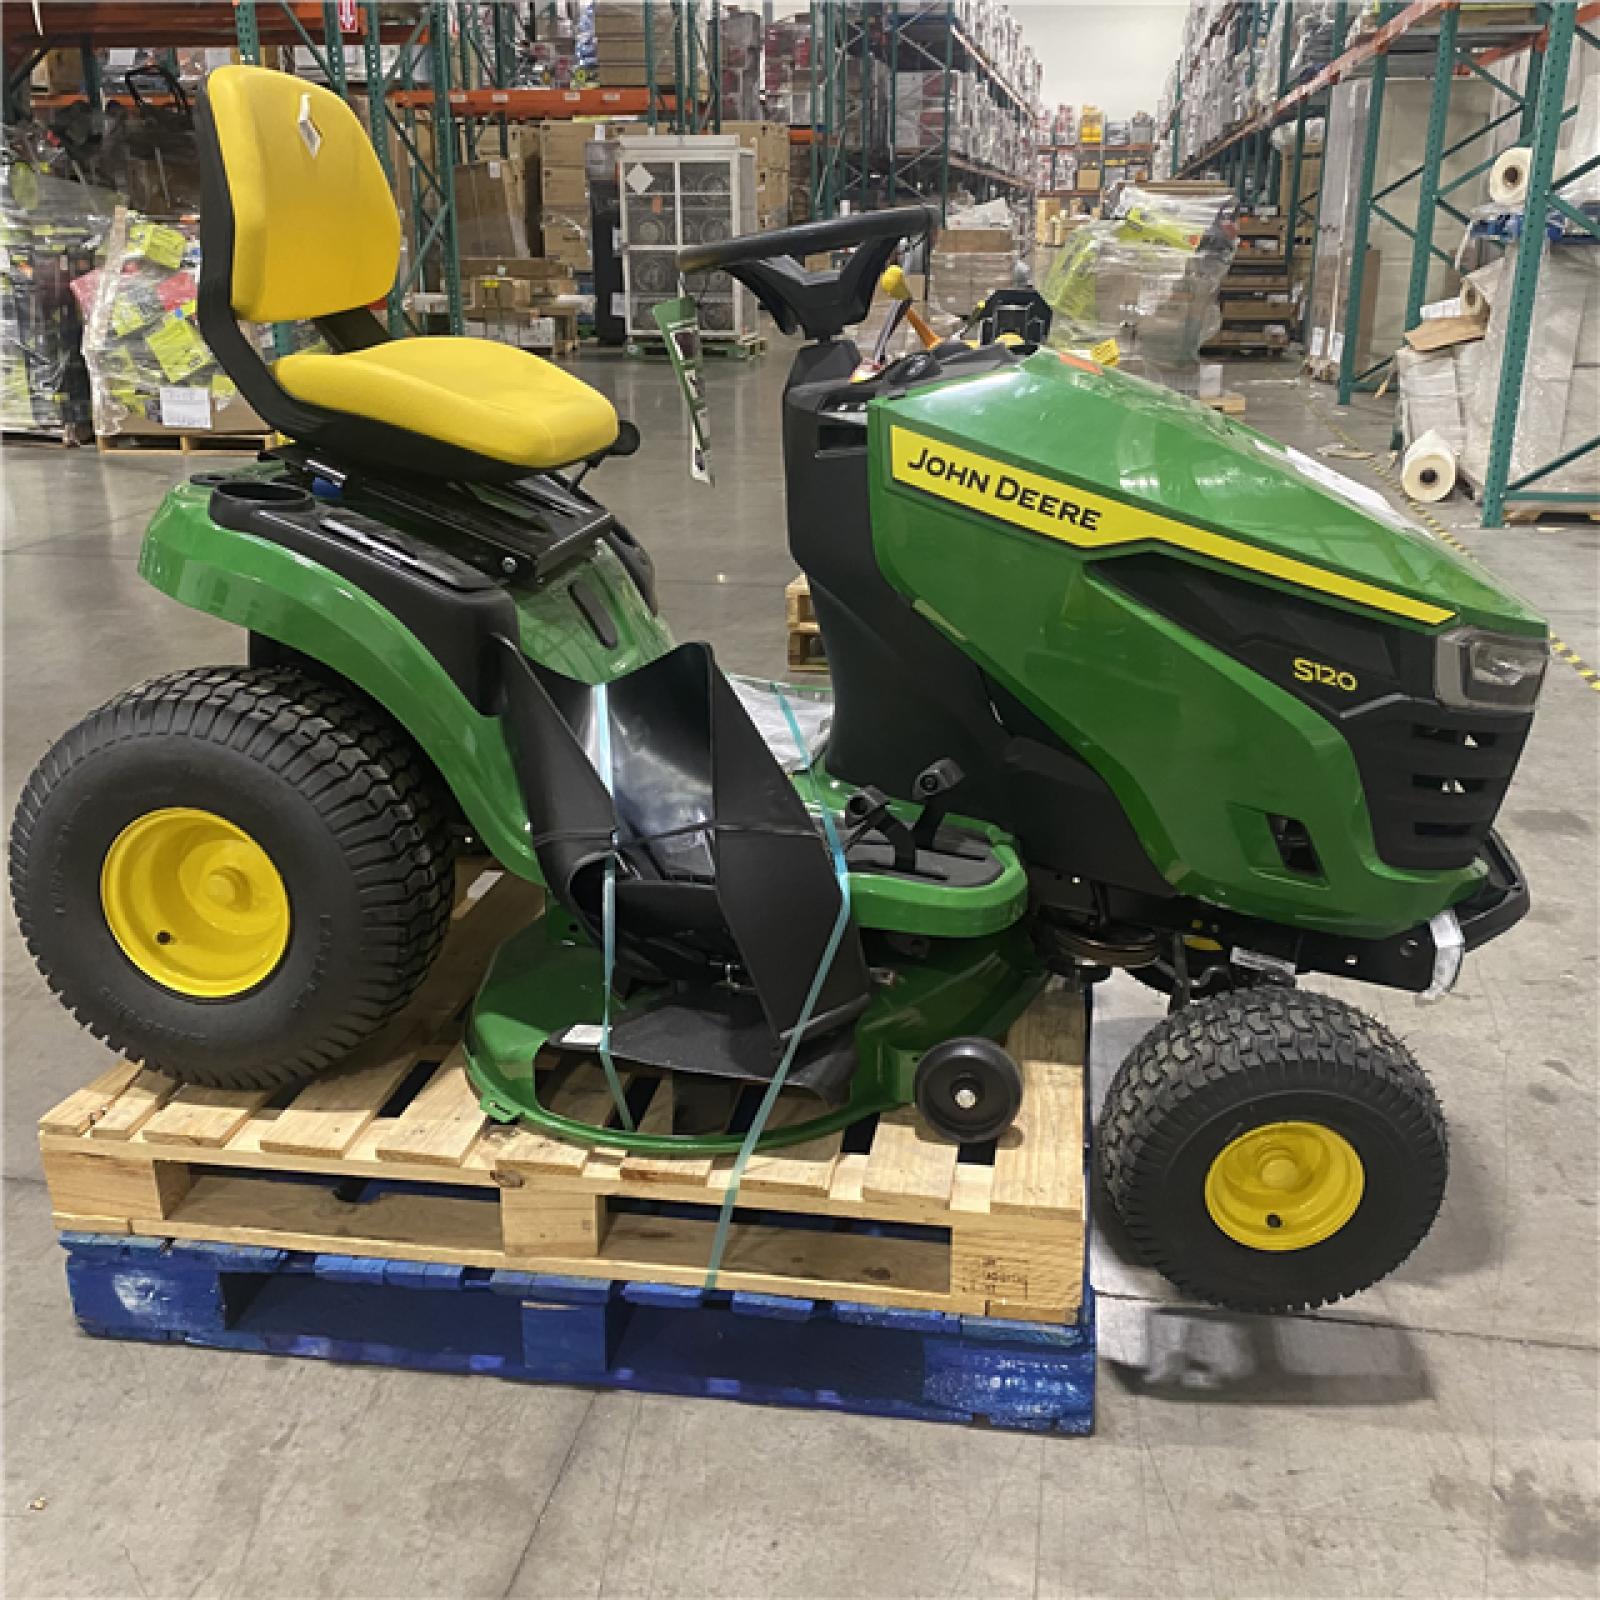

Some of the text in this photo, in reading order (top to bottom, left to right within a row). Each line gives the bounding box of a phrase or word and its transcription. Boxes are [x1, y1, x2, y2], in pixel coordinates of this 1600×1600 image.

[907, 448, 1102, 531] JOHN DEERE
[1293, 657, 1357, 691] S120
